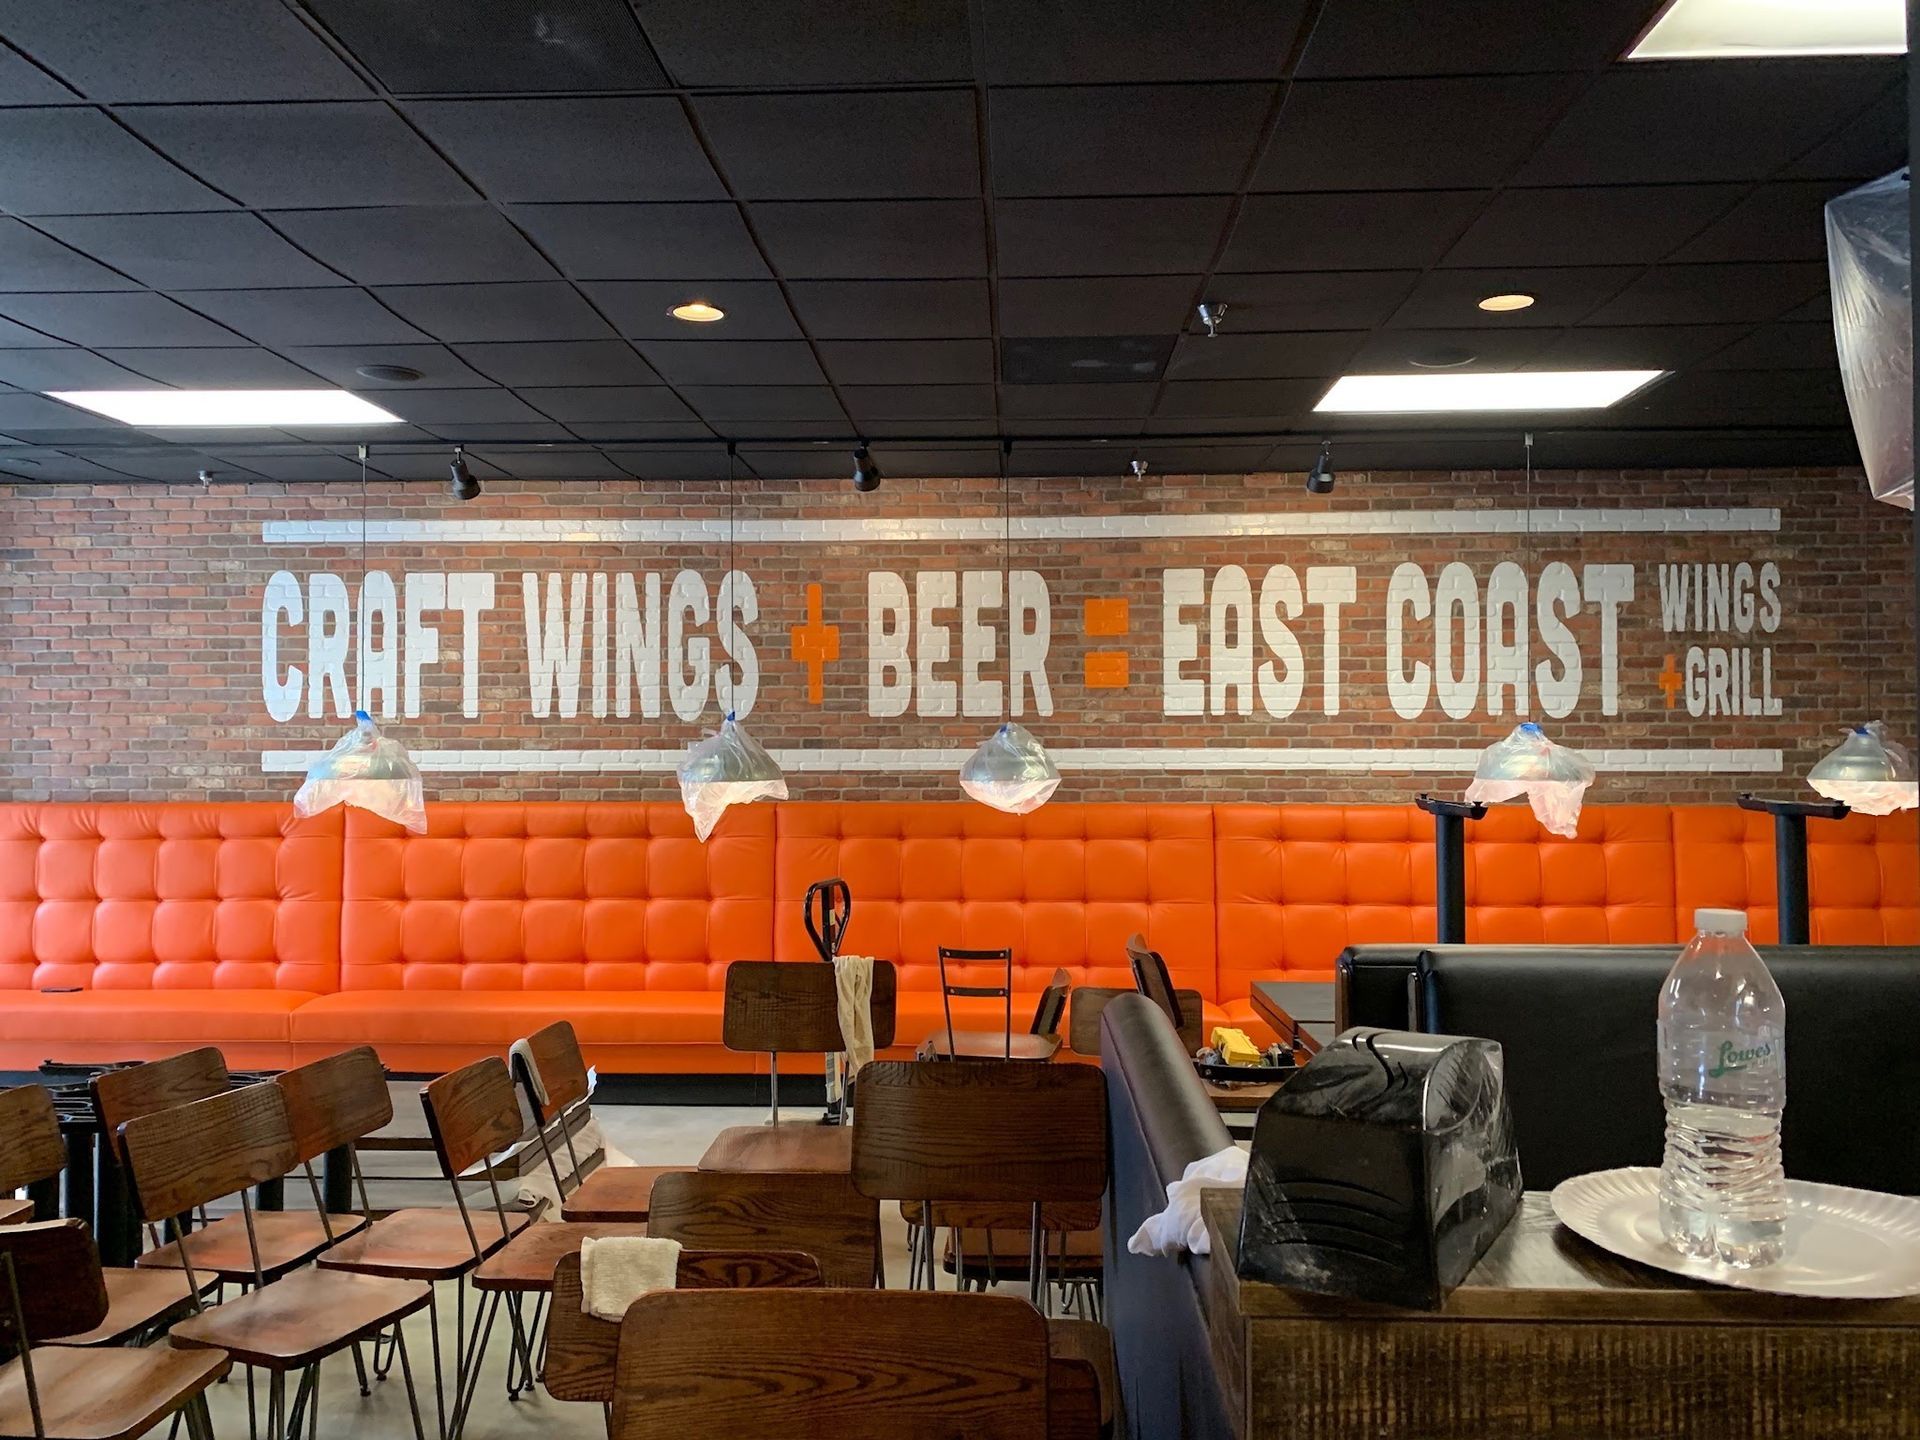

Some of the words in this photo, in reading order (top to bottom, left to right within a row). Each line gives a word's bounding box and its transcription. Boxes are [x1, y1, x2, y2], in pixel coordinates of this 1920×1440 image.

[1659, 562, 1781, 633] WINGS
[262, 569, 495, 722] CRAFT
[523, 569, 759, 722] WINGS
[868, 571, 1053, 718] BEER
[1163, 563, 1357, 719] EAST
[1386, 561, 1635, 720] COAST
[1708, 1041, 1771, 1078] Lowes
